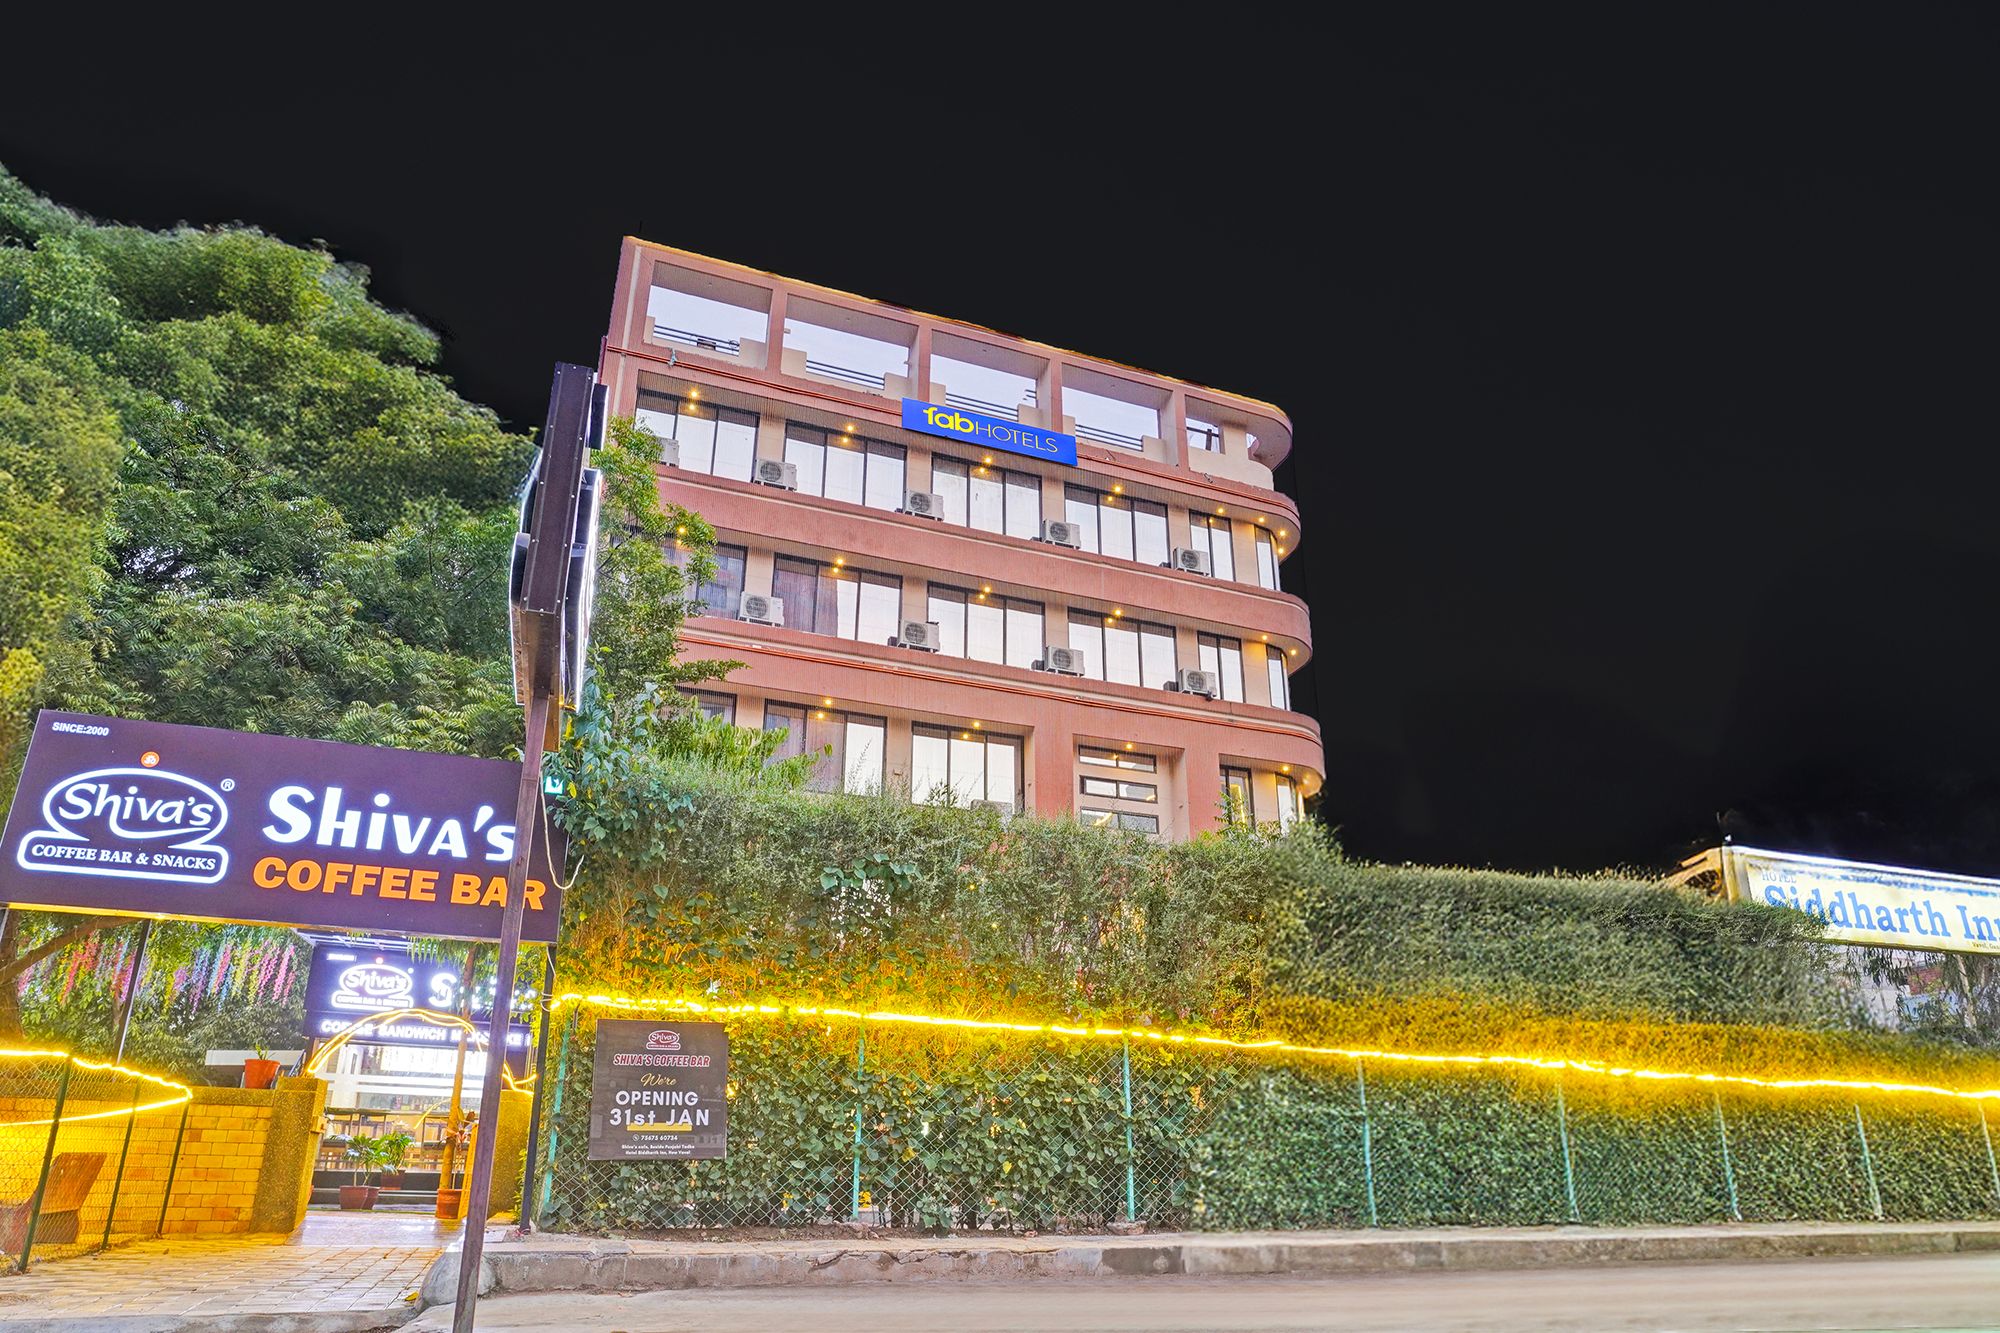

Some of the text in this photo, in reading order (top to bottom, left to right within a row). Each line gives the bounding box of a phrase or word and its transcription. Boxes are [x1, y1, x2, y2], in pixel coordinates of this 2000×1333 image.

[58, 783, 214, 838] Shiva's
[32, 844, 216, 870] COFFEE BAR & SNACKS
[253, 857, 546, 910] COFFEE BAR
[1765, 885, 2000, 941] Siddharth In
[379, 1023, 446, 1041] SANDWICH
[613, 1053, 711, 1068] SHIVA'S COFFEE BAR
[640, 1072, 677, 1087] We're
[615, 1090, 699, 1106] OPENING
[610, 1108, 709, 1126] 31st JAN
